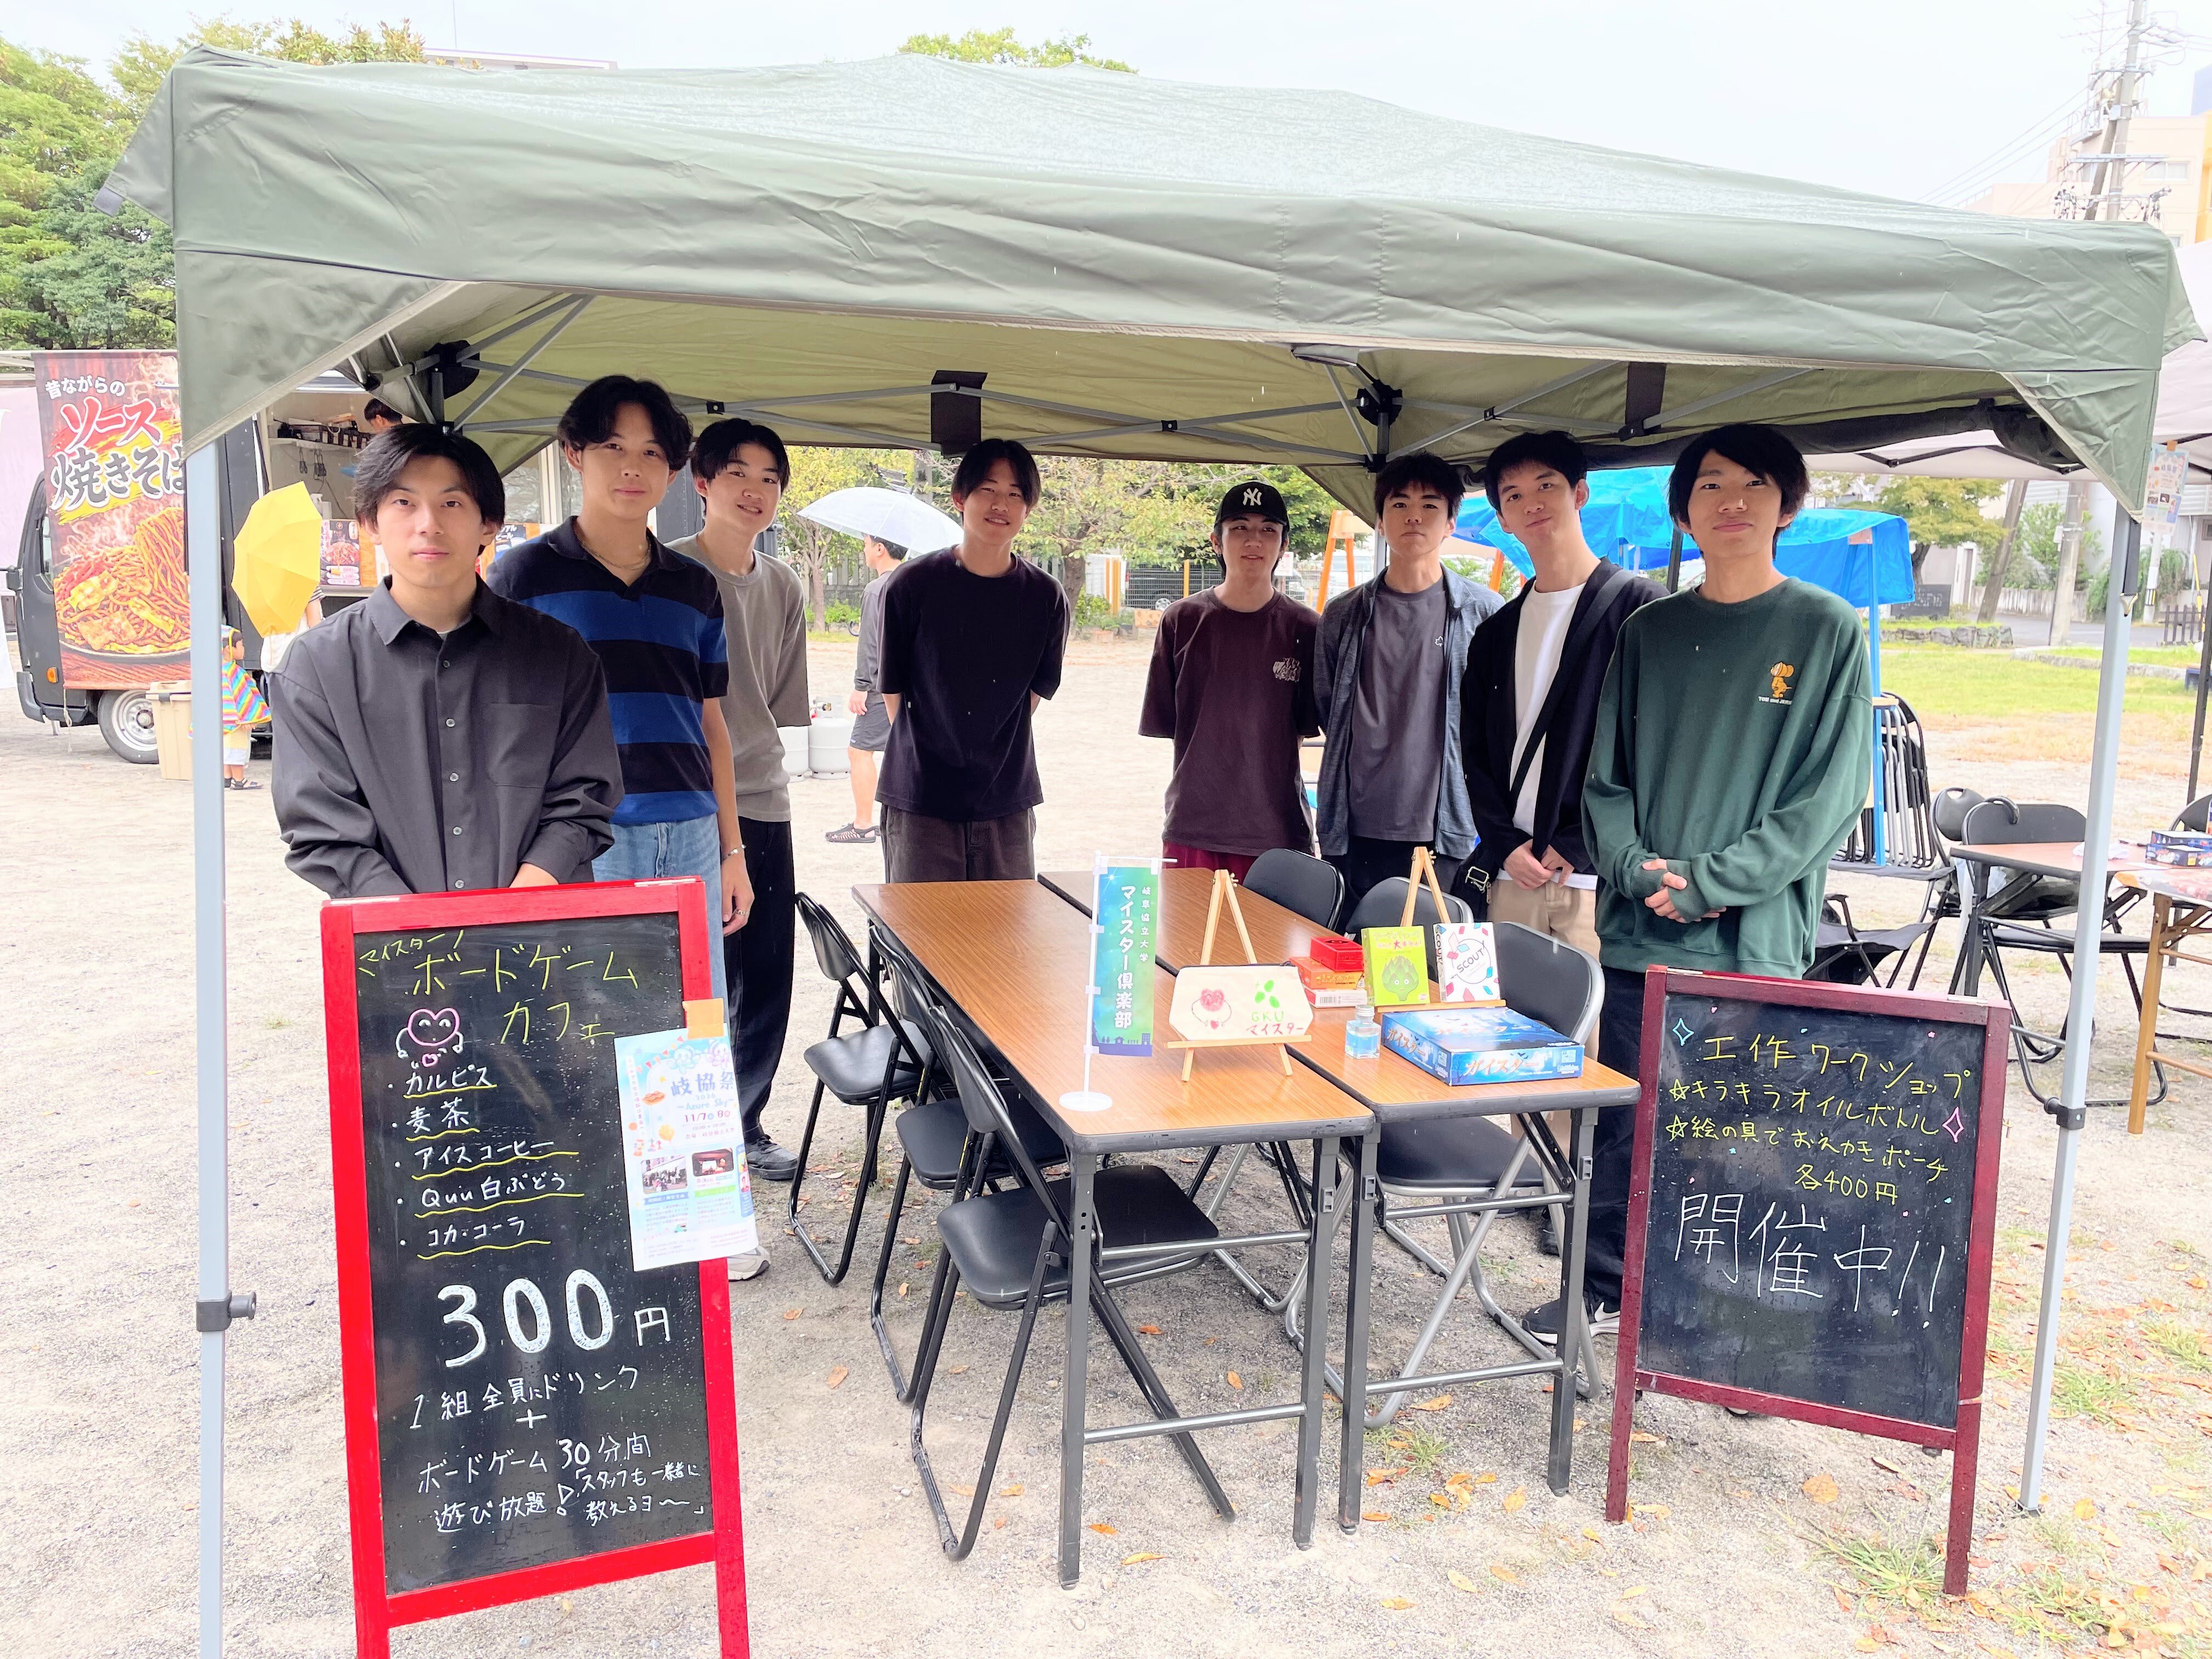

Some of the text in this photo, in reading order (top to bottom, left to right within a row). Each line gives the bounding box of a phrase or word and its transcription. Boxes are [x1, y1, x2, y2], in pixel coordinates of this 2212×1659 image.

[46, 375, 126, 399] 昔ながらの
[60, 396, 163, 452] ソース
[1243, 488, 1262, 506] NY
[1139, 886, 1151, 962] 岐阜協立大学
[359, 933, 446, 962] マイスター
[1114, 885, 1136, 1029] マイスター倶楽部
[1457, 948, 1484, 973] SCOUT
[413, 944, 639, 996] ボードゲーム
[500, 1001, 616, 1043] カフェ
[1246, 1023, 1304, 1036] マイスター
[1251, 1011, 1284, 1022] GKU
[1386, 1028, 1426, 1057] ガイスター
[406, 1064, 493, 1094] カルピス
[1463, 1056, 1541, 1076] ガイスター
[407, 1097, 470, 1133] 麦茶
[415, 1141, 555, 1170] アイスコーヒー
[1796, 1164, 1898, 1204] 各400円
[428, 1216, 525, 1247] コカ・コーラ
